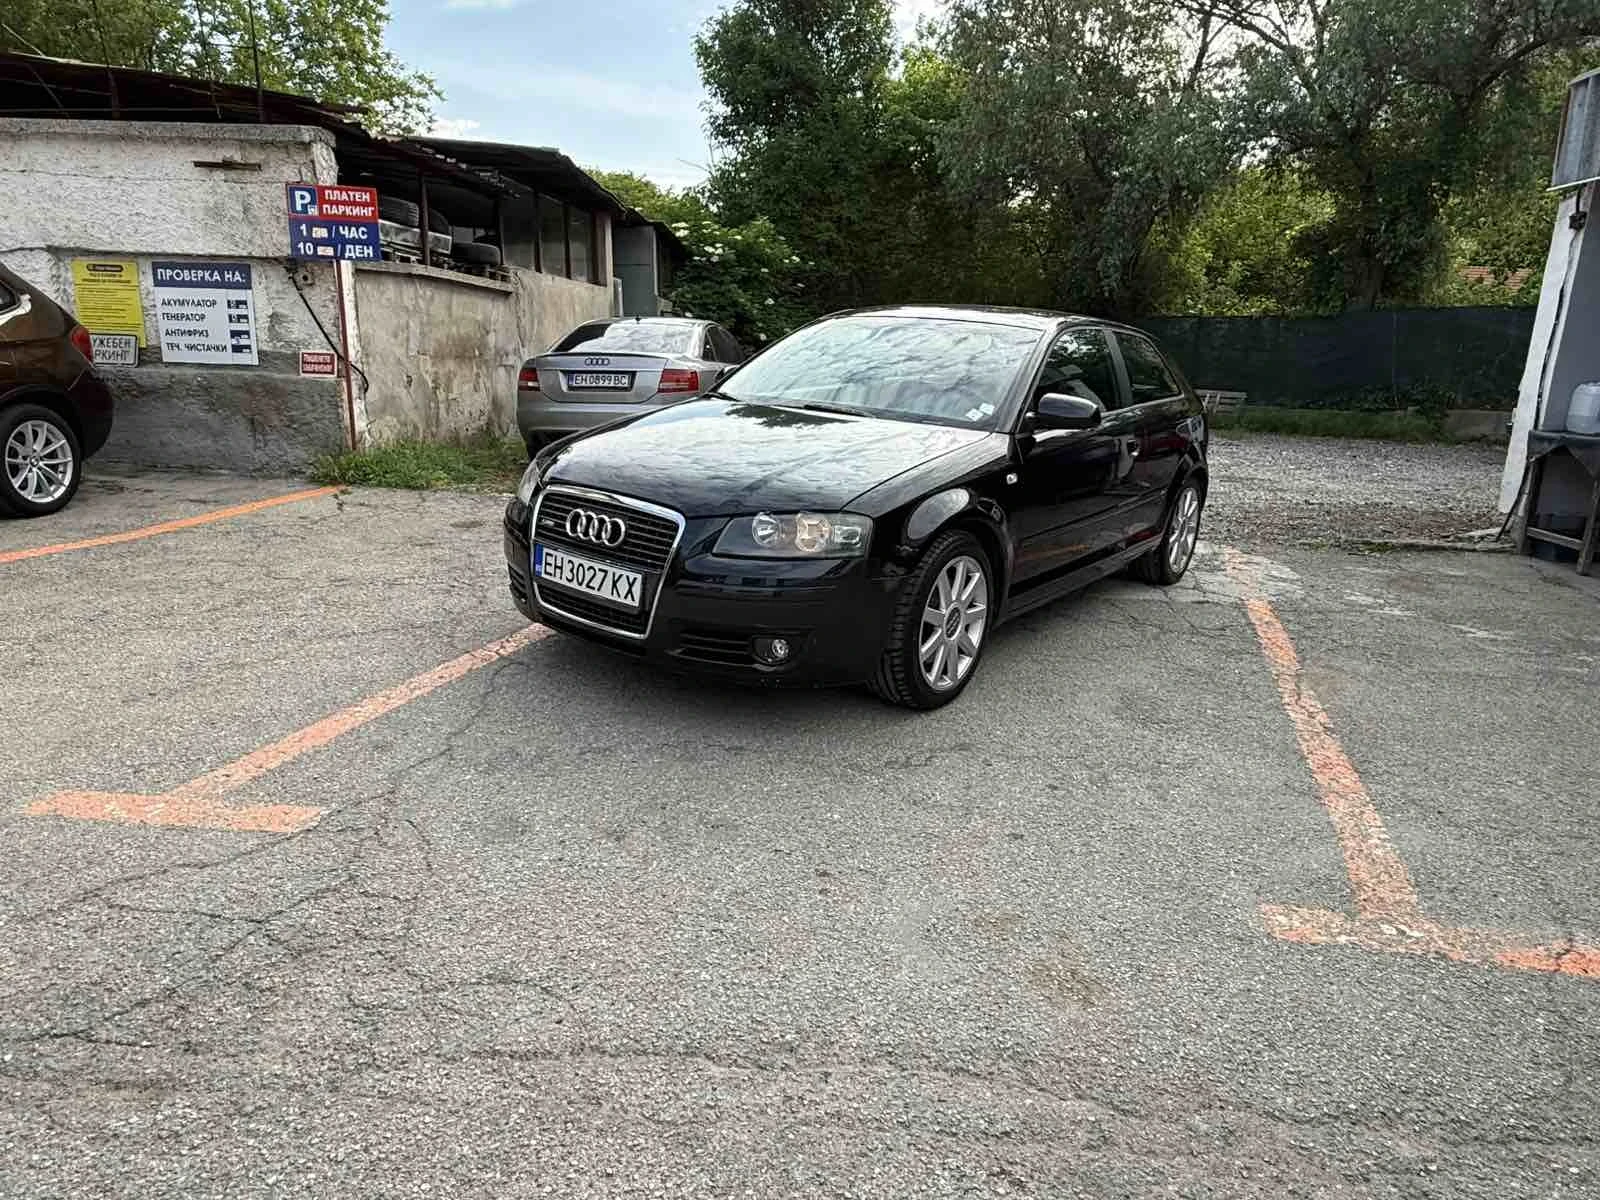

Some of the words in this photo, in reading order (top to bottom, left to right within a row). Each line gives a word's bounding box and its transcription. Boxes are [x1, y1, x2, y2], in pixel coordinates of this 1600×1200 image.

[294, 190, 311, 211] P
[324, 189, 371, 202] ПЛАТЕН
[322, 204, 375, 217] ПАРКИНГ
[300, 223, 307, 237] 1
[339, 225, 368, 240] ЧАС
[297, 241, 314, 255] 10
[344, 244, 374, 259] ДЕН
[156, 268, 221, 281] ПРОВЕРКА
[224, 270, 246, 283] НА:
[160, 298, 217, 309] АКУМУЛАТОР
[161, 312, 206, 322] ГЕНЕРАТОР
[164, 328, 208, 338] АНТИФРИЗ
[184, 343, 228, 353] ЧИСТАЧКИ
